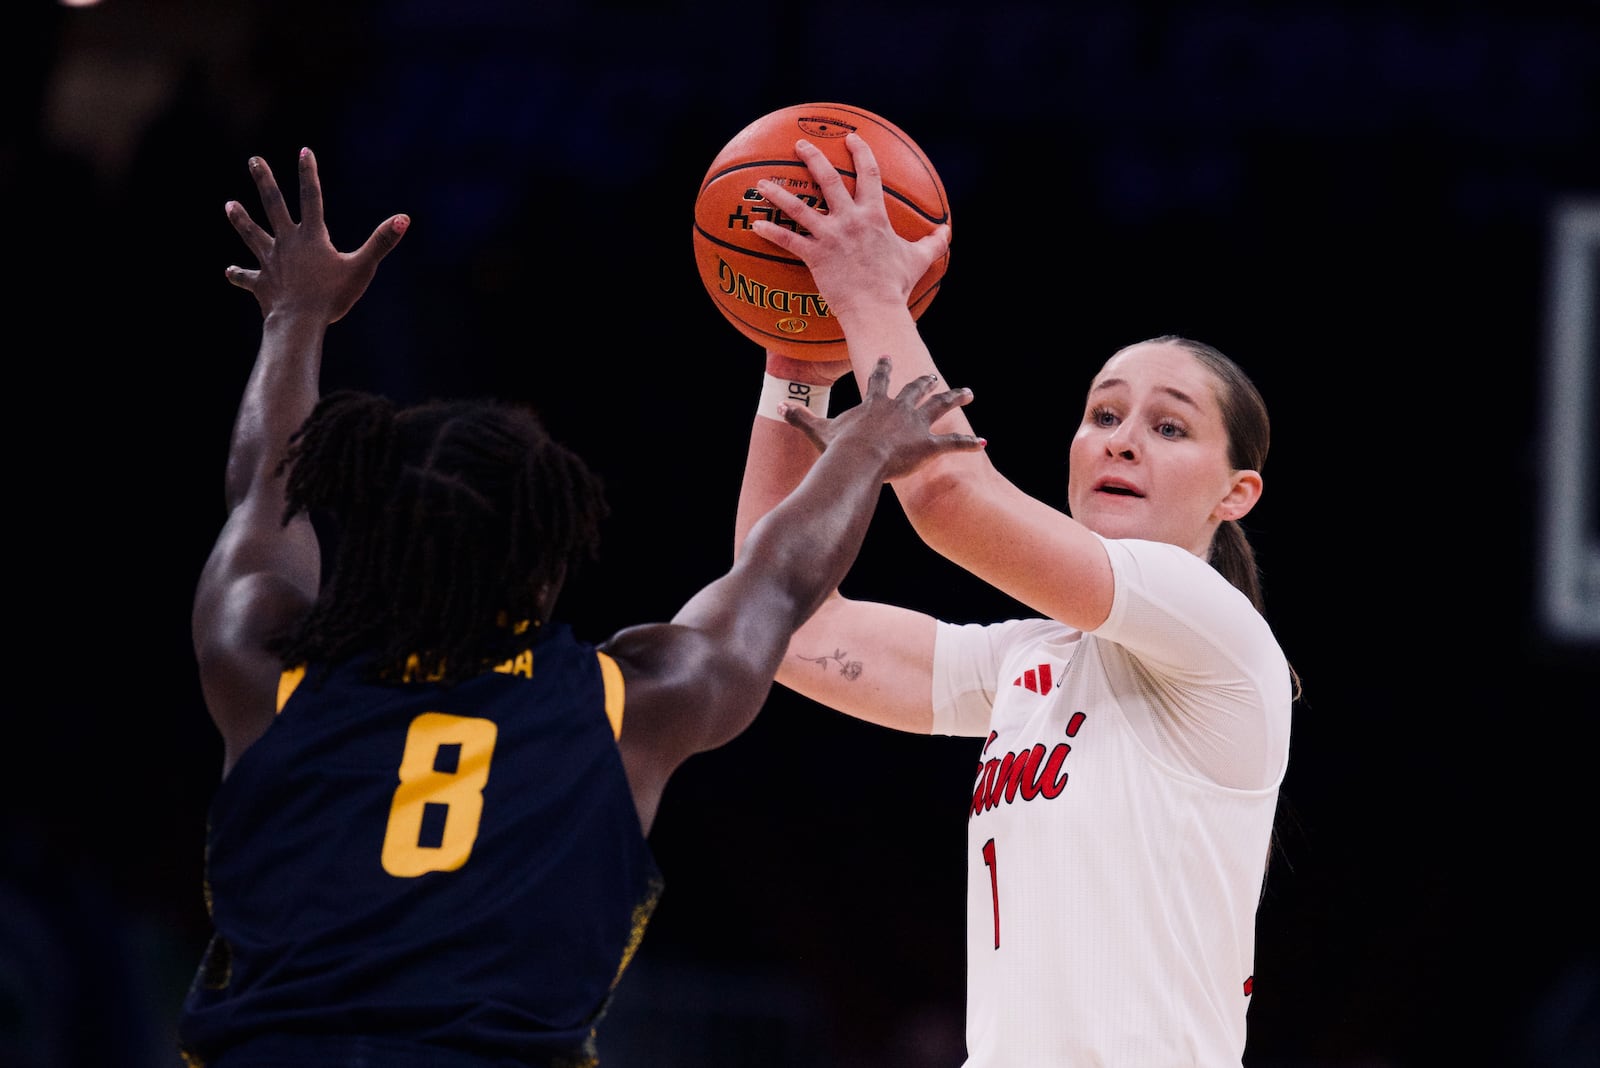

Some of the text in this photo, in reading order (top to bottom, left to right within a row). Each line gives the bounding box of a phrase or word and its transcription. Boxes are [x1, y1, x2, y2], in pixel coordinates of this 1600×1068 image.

[718, 257, 830, 318] ALDING
[381, 712, 498, 877] 8
[982, 837, 1000, 951] 1
